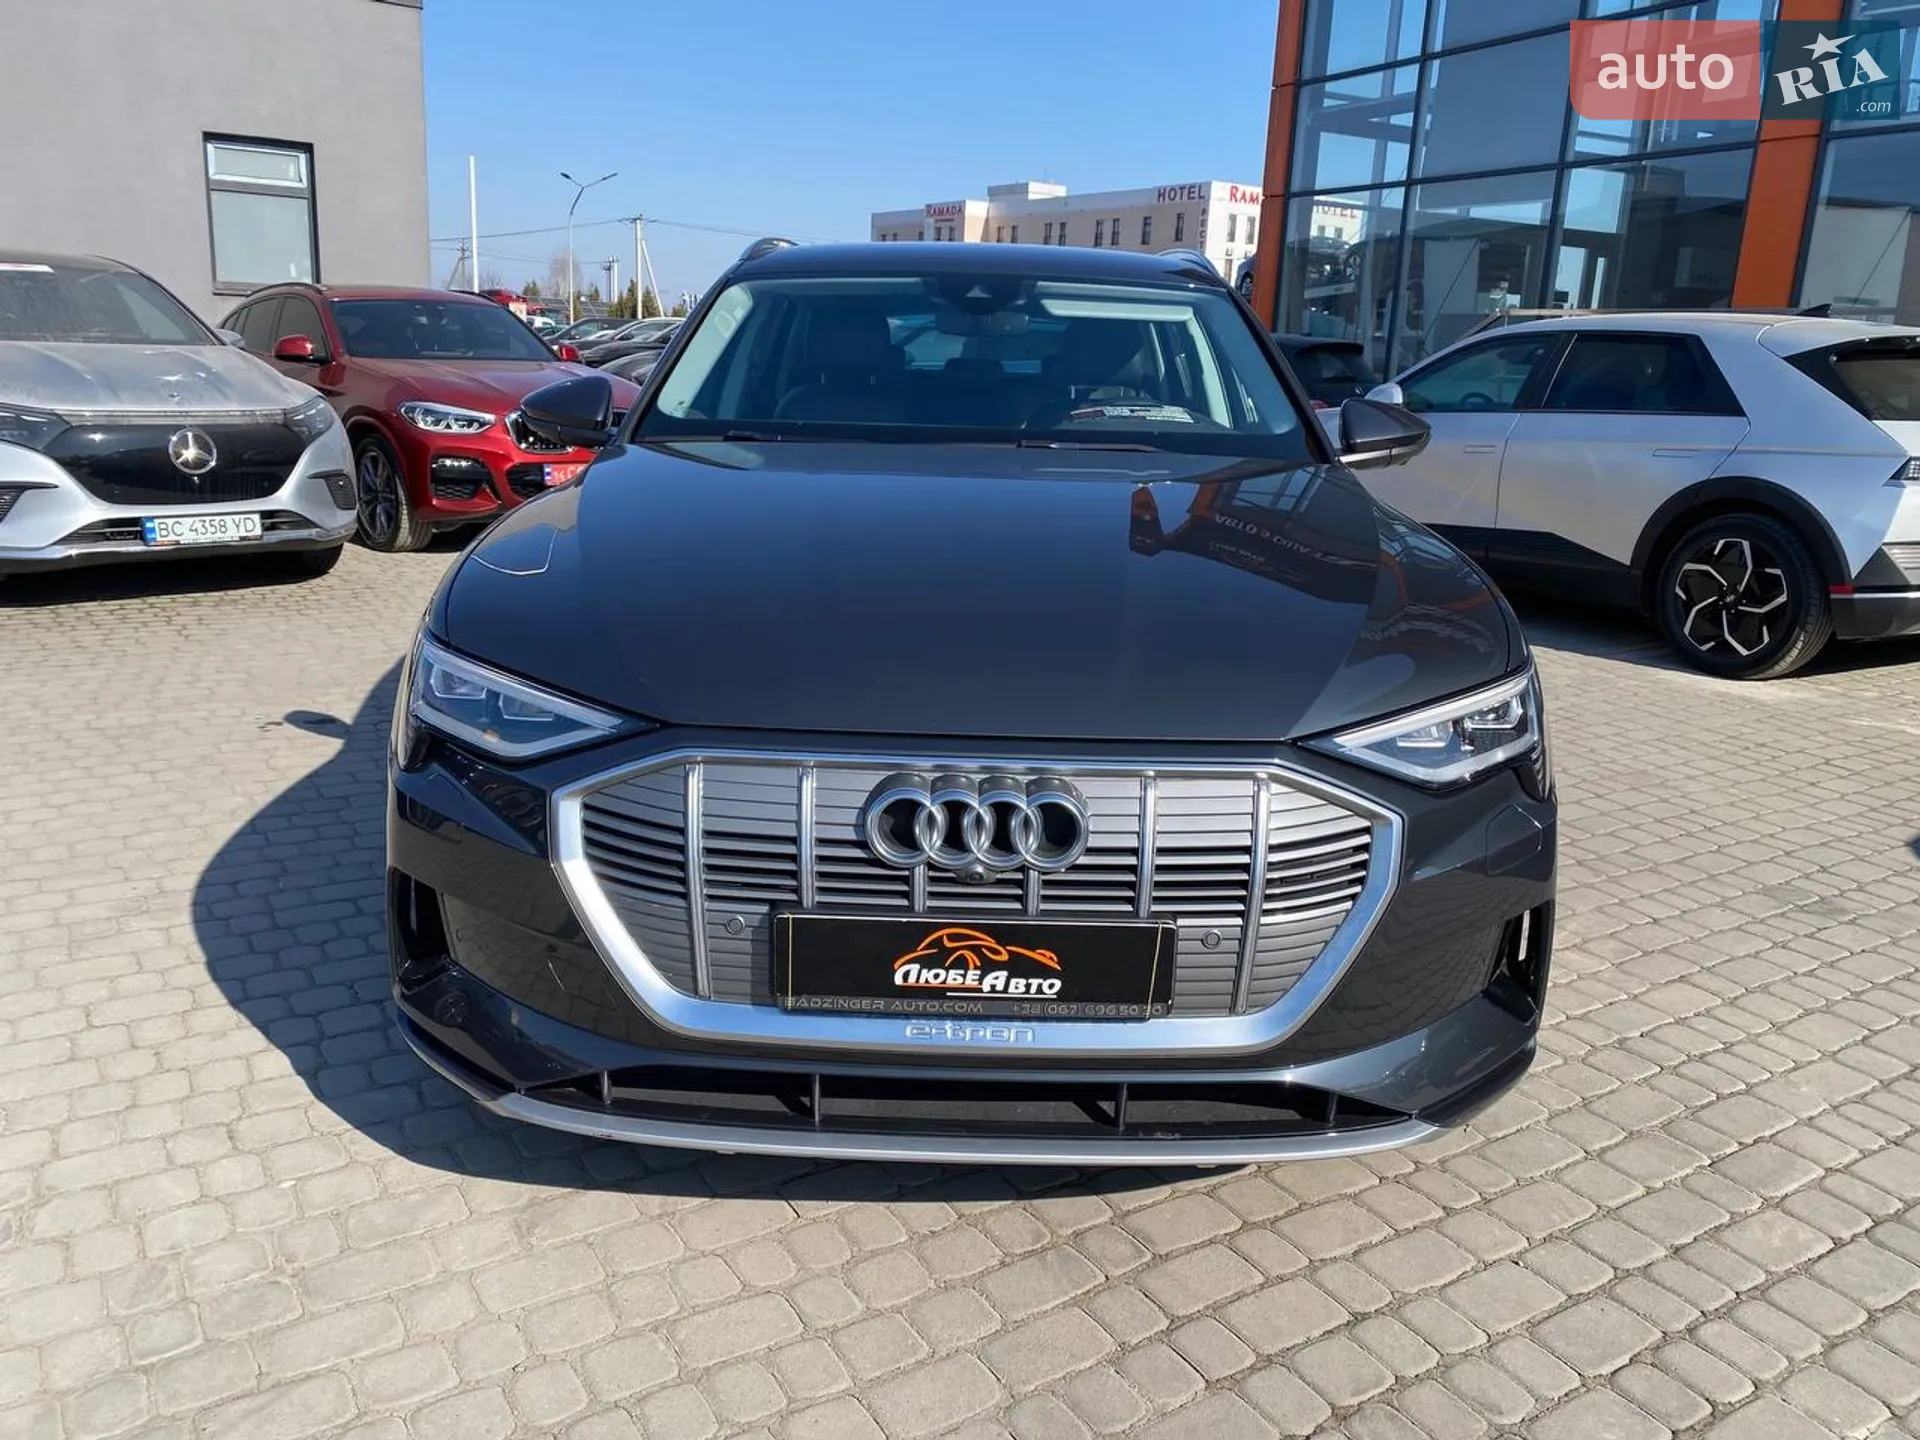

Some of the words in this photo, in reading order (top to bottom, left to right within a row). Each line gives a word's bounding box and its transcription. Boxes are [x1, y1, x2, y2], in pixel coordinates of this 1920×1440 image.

[1157, 185, 1205, 202] HOTEL
[925, 203, 963, 218] RAMADA
[157, 521, 184, 538] BC
[189, 518, 228, 536] 4358
[231, 517, 256, 534] YD
[906, 1020, 1034, 1042] e-tron
